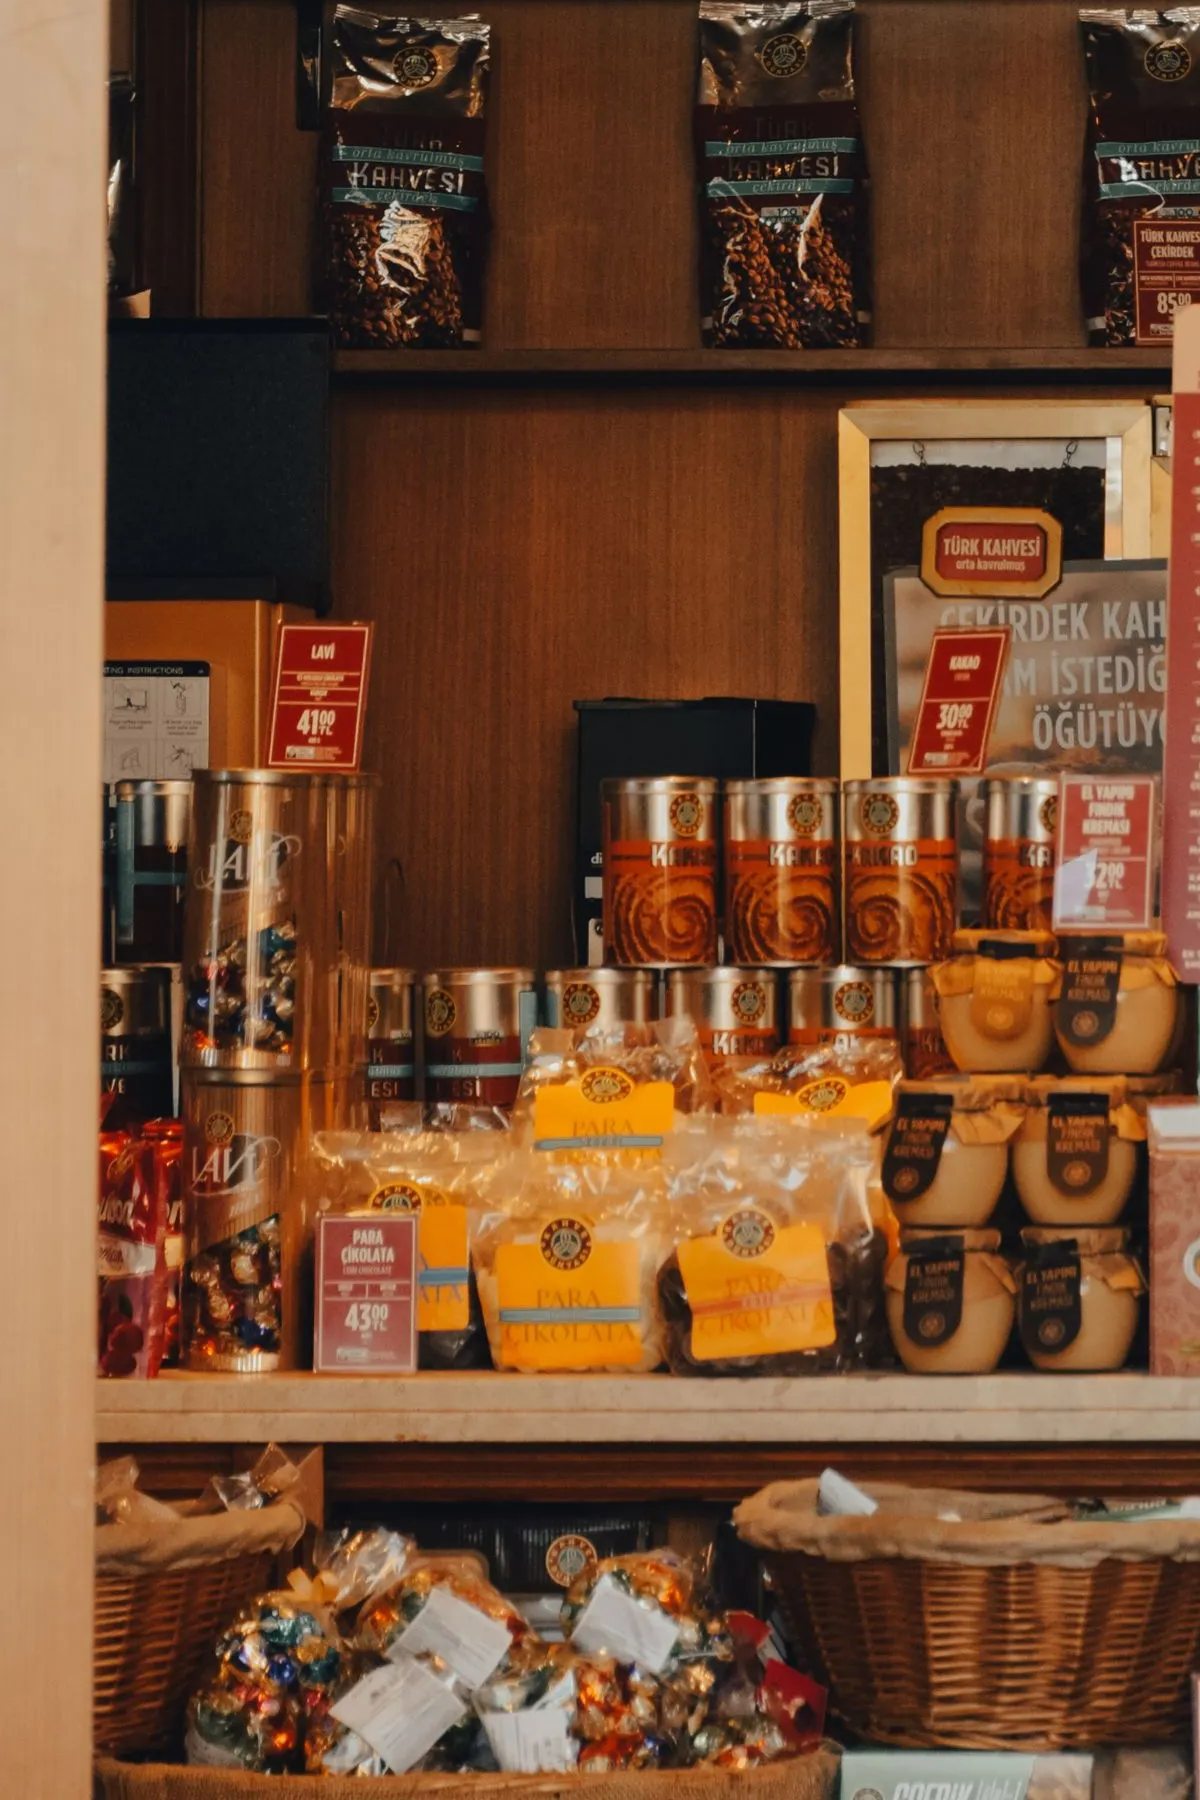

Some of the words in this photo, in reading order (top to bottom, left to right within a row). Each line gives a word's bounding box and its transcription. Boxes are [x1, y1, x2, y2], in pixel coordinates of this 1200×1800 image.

[348, 161, 465, 195] KAHVESİ
[1173, 207, 1195, 218] 100
[1140, 227, 1165, 244] TÜRK
[1151, 243, 1195, 260] ÇEKİRDEK
[943, 535, 980, 556] TÜRK
[982, 534, 1042, 557] KAHVESİ
[955, 558, 976, 571] orta
[977, 557, 1027, 574] kavrulmuş
[311, 641, 337, 661] LAVİ
[127, 666, 185, 676] INSTRUCTIONS
[948, 655, 982, 671] KAKAO
[1032, 700, 1167, 751] ÖĞÜTÜY
[1081, 784, 1094, 801] EL
[1096, 784, 1135, 801] YAPIMI
[1088, 801, 1127, 818] FINDIK
[1082, 818, 1131, 836] KREMASI
[352, 1227, 384, 1246] PARA
[341, 1242, 396, 1264] ÇİKOLATA
[536, 1288, 601, 1310] PARA
